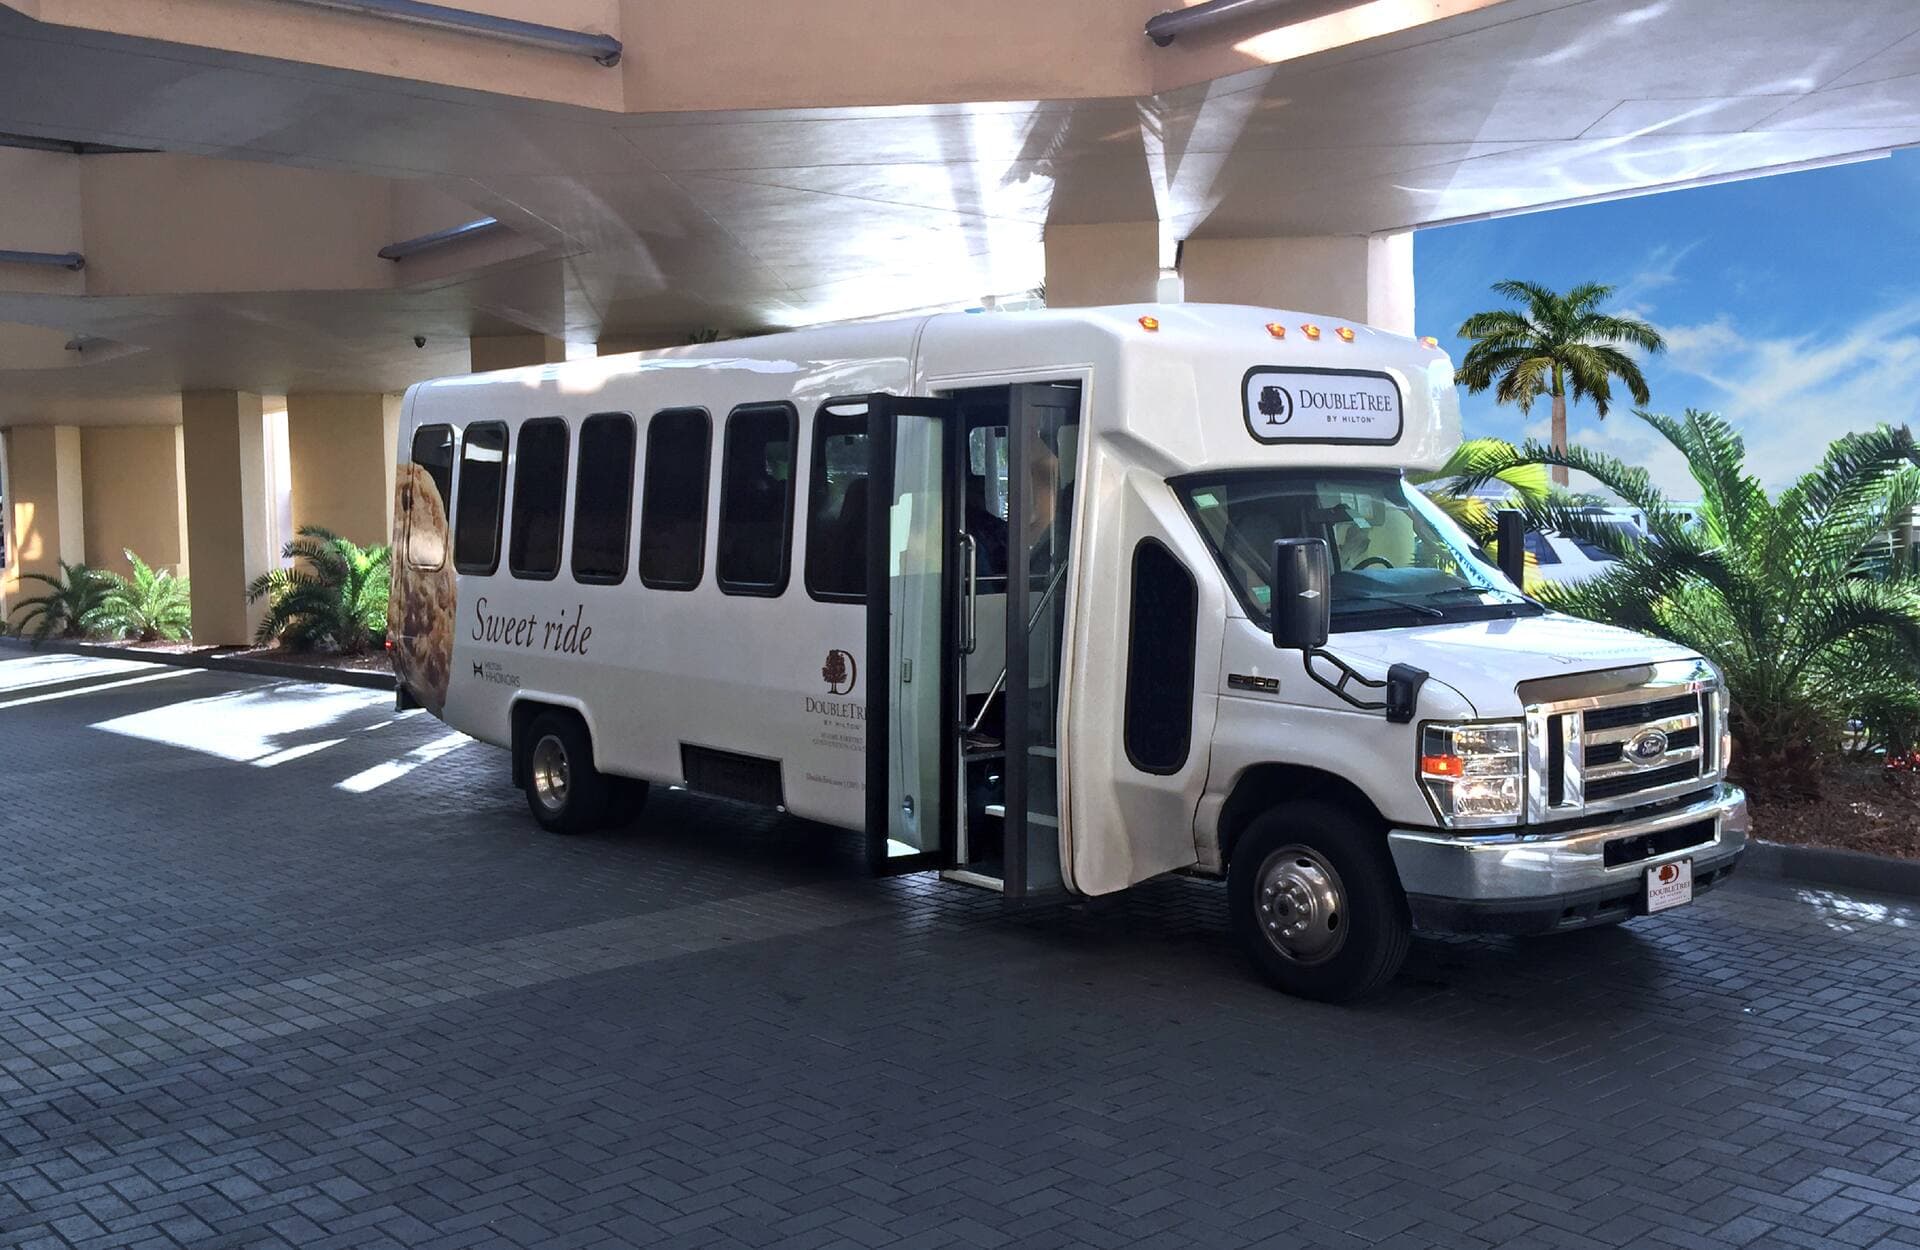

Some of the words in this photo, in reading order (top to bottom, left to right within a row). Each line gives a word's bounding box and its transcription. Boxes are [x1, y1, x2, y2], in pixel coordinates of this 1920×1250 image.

[1299, 389, 1393, 412] DOUBLETREE
[1327, 415, 1337, 423] BY
[1343, 415, 1372, 424] HILTON
[471, 597, 537, 648] Sweet
[543, 604, 593, 655] ride
[485, 671, 521, 688] HHONORS
[806, 696, 867, 720] DOUBLETR
